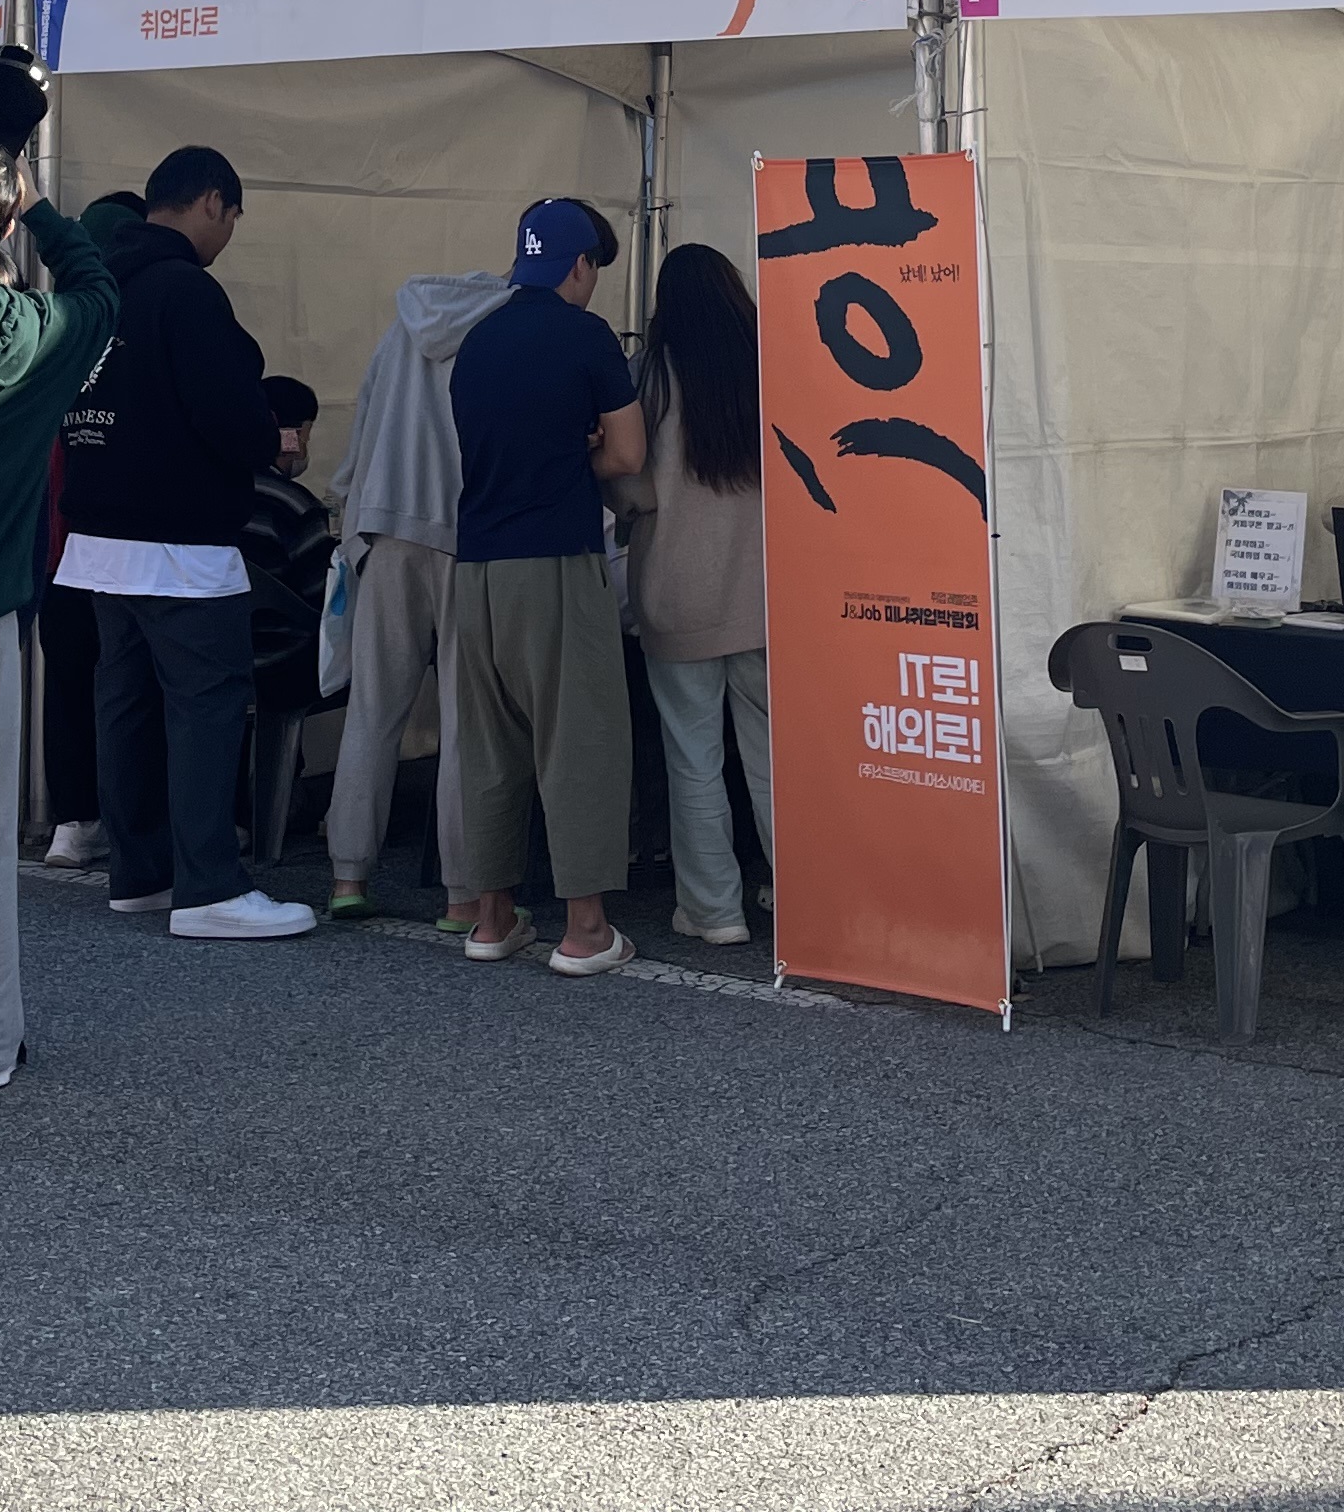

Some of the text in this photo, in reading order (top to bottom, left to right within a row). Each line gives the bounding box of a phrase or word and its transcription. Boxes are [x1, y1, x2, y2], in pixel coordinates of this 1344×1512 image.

[139, 6, 219, 40] 취업타로
[525, 228, 542, 255] LA
[841, 602, 979, 630] J&Job 미니취업박람회
[898, 651, 980, 706] IT로!
[862, 702, 982, 764] 해외로!
